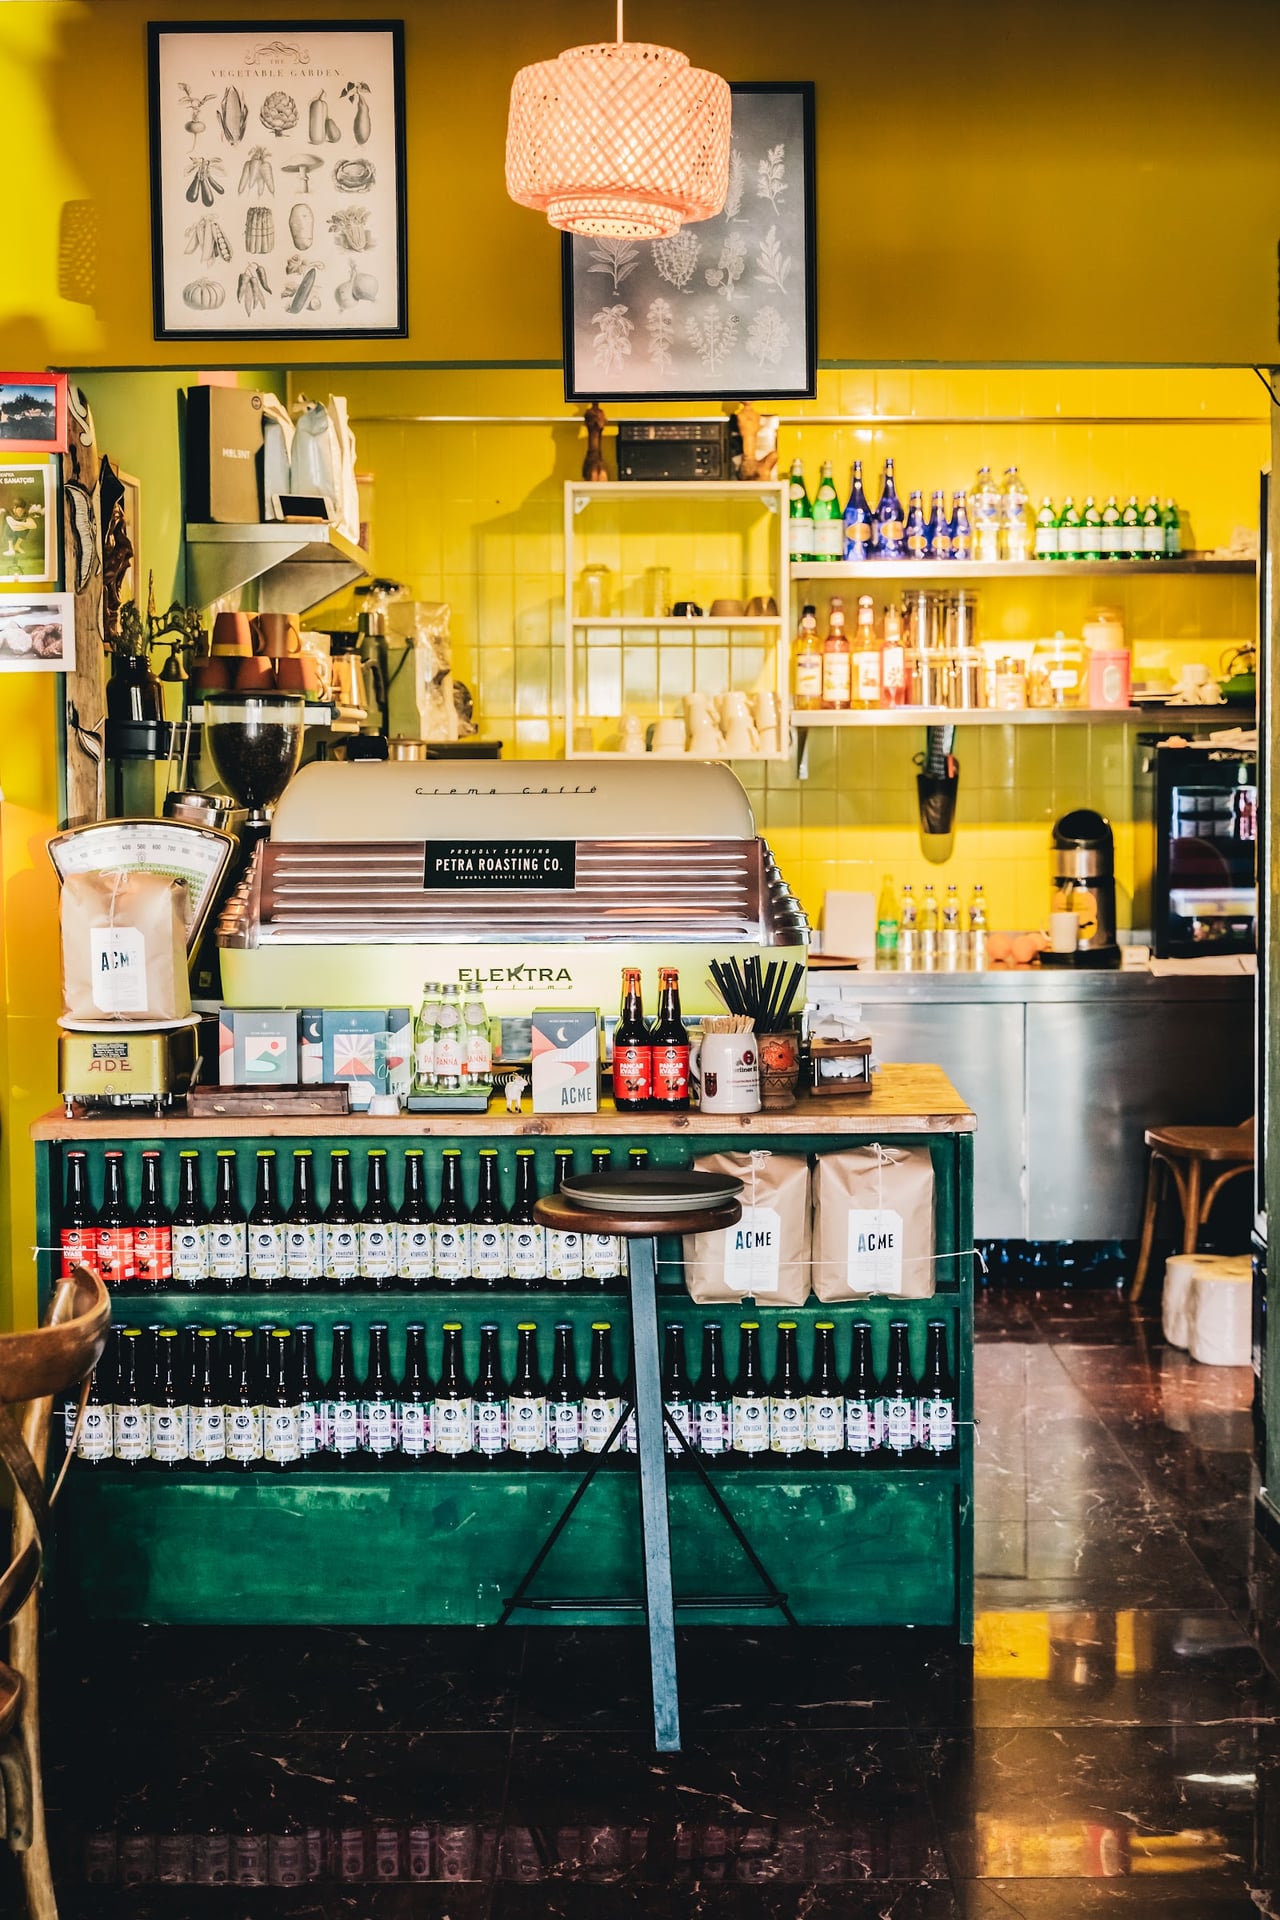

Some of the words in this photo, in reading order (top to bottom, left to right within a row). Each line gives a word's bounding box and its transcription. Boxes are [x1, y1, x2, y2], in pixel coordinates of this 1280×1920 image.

[211, 69, 283, 77] VEGETABLE
[415, 787, 497, 796] Crema
[435, 858, 474, 871] PETRA
[478, 858, 539, 871] ROASTING
[543, 858, 564, 871] CO.
[458, 963, 573, 982] ELEKTRA
[88, 1060, 132, 1072] ADE
[561, 1087, 592, 1106] ACME
[735, 1230, 772, 1250] ACME
[857, 1233, 894, 1253] ACME
